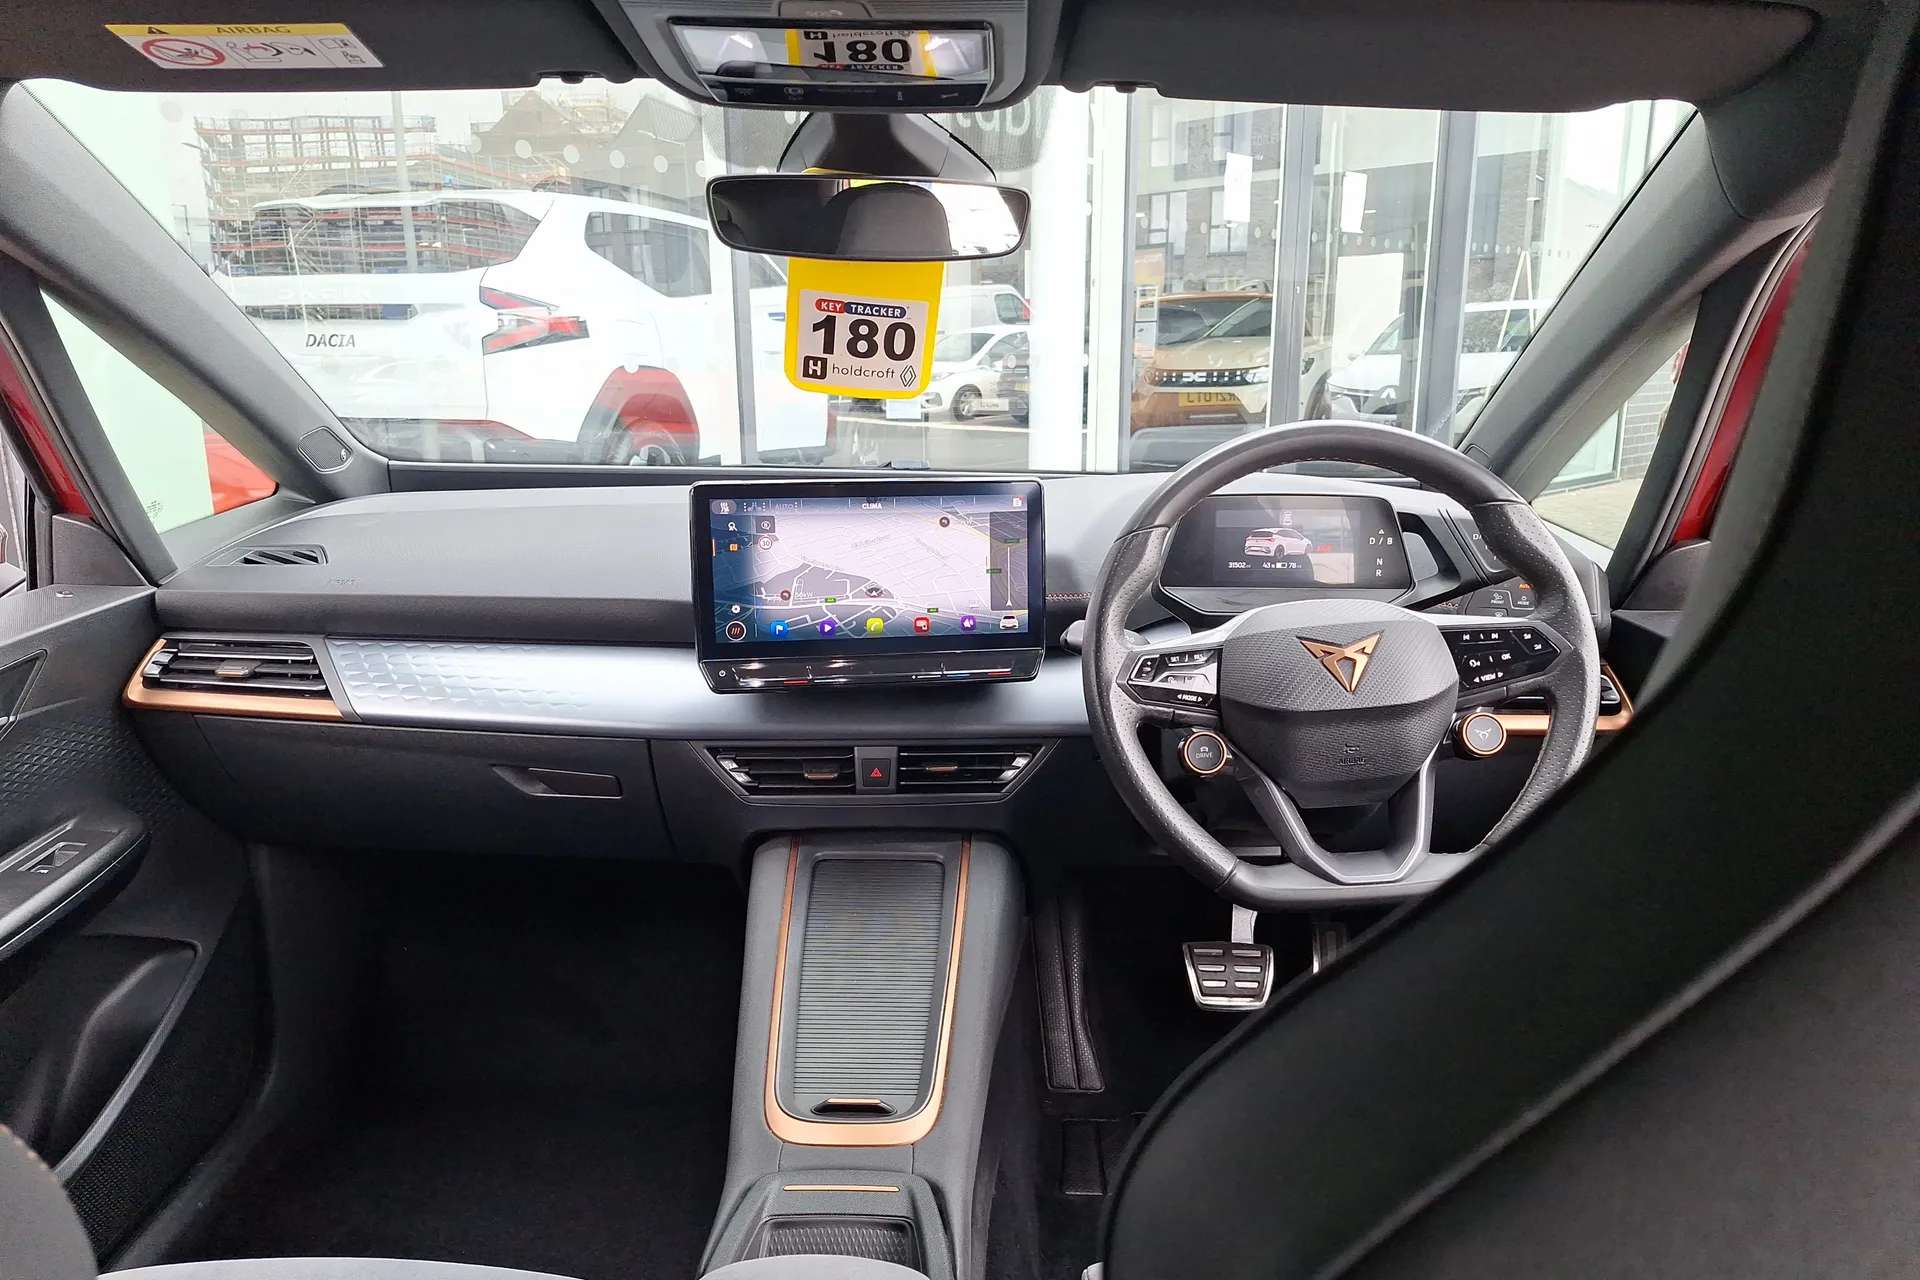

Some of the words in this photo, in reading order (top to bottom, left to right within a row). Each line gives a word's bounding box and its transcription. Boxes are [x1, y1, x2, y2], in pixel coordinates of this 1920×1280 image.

[216, 25, 291, 34] AIRBAG
[819, 300, 842, 312] KEY
[850, 304, 901, 318] TRACKER
[305, 333, 356, 348] DACIA
[812, 314, 916, 361] 180
[832, 363, 895, 379] holdcroft
[862, 502, 883, 510] CLIMA
[1369, 537, 1376, 545] D
[1228, 561, 1246, 569] 31502
[1376, 558, 1383, 566] N
[1375, 569, 1382, 577] R
[1480, 673, 1496, 682] VIEW
[1195, 752, 1213, 760] DRIVE
